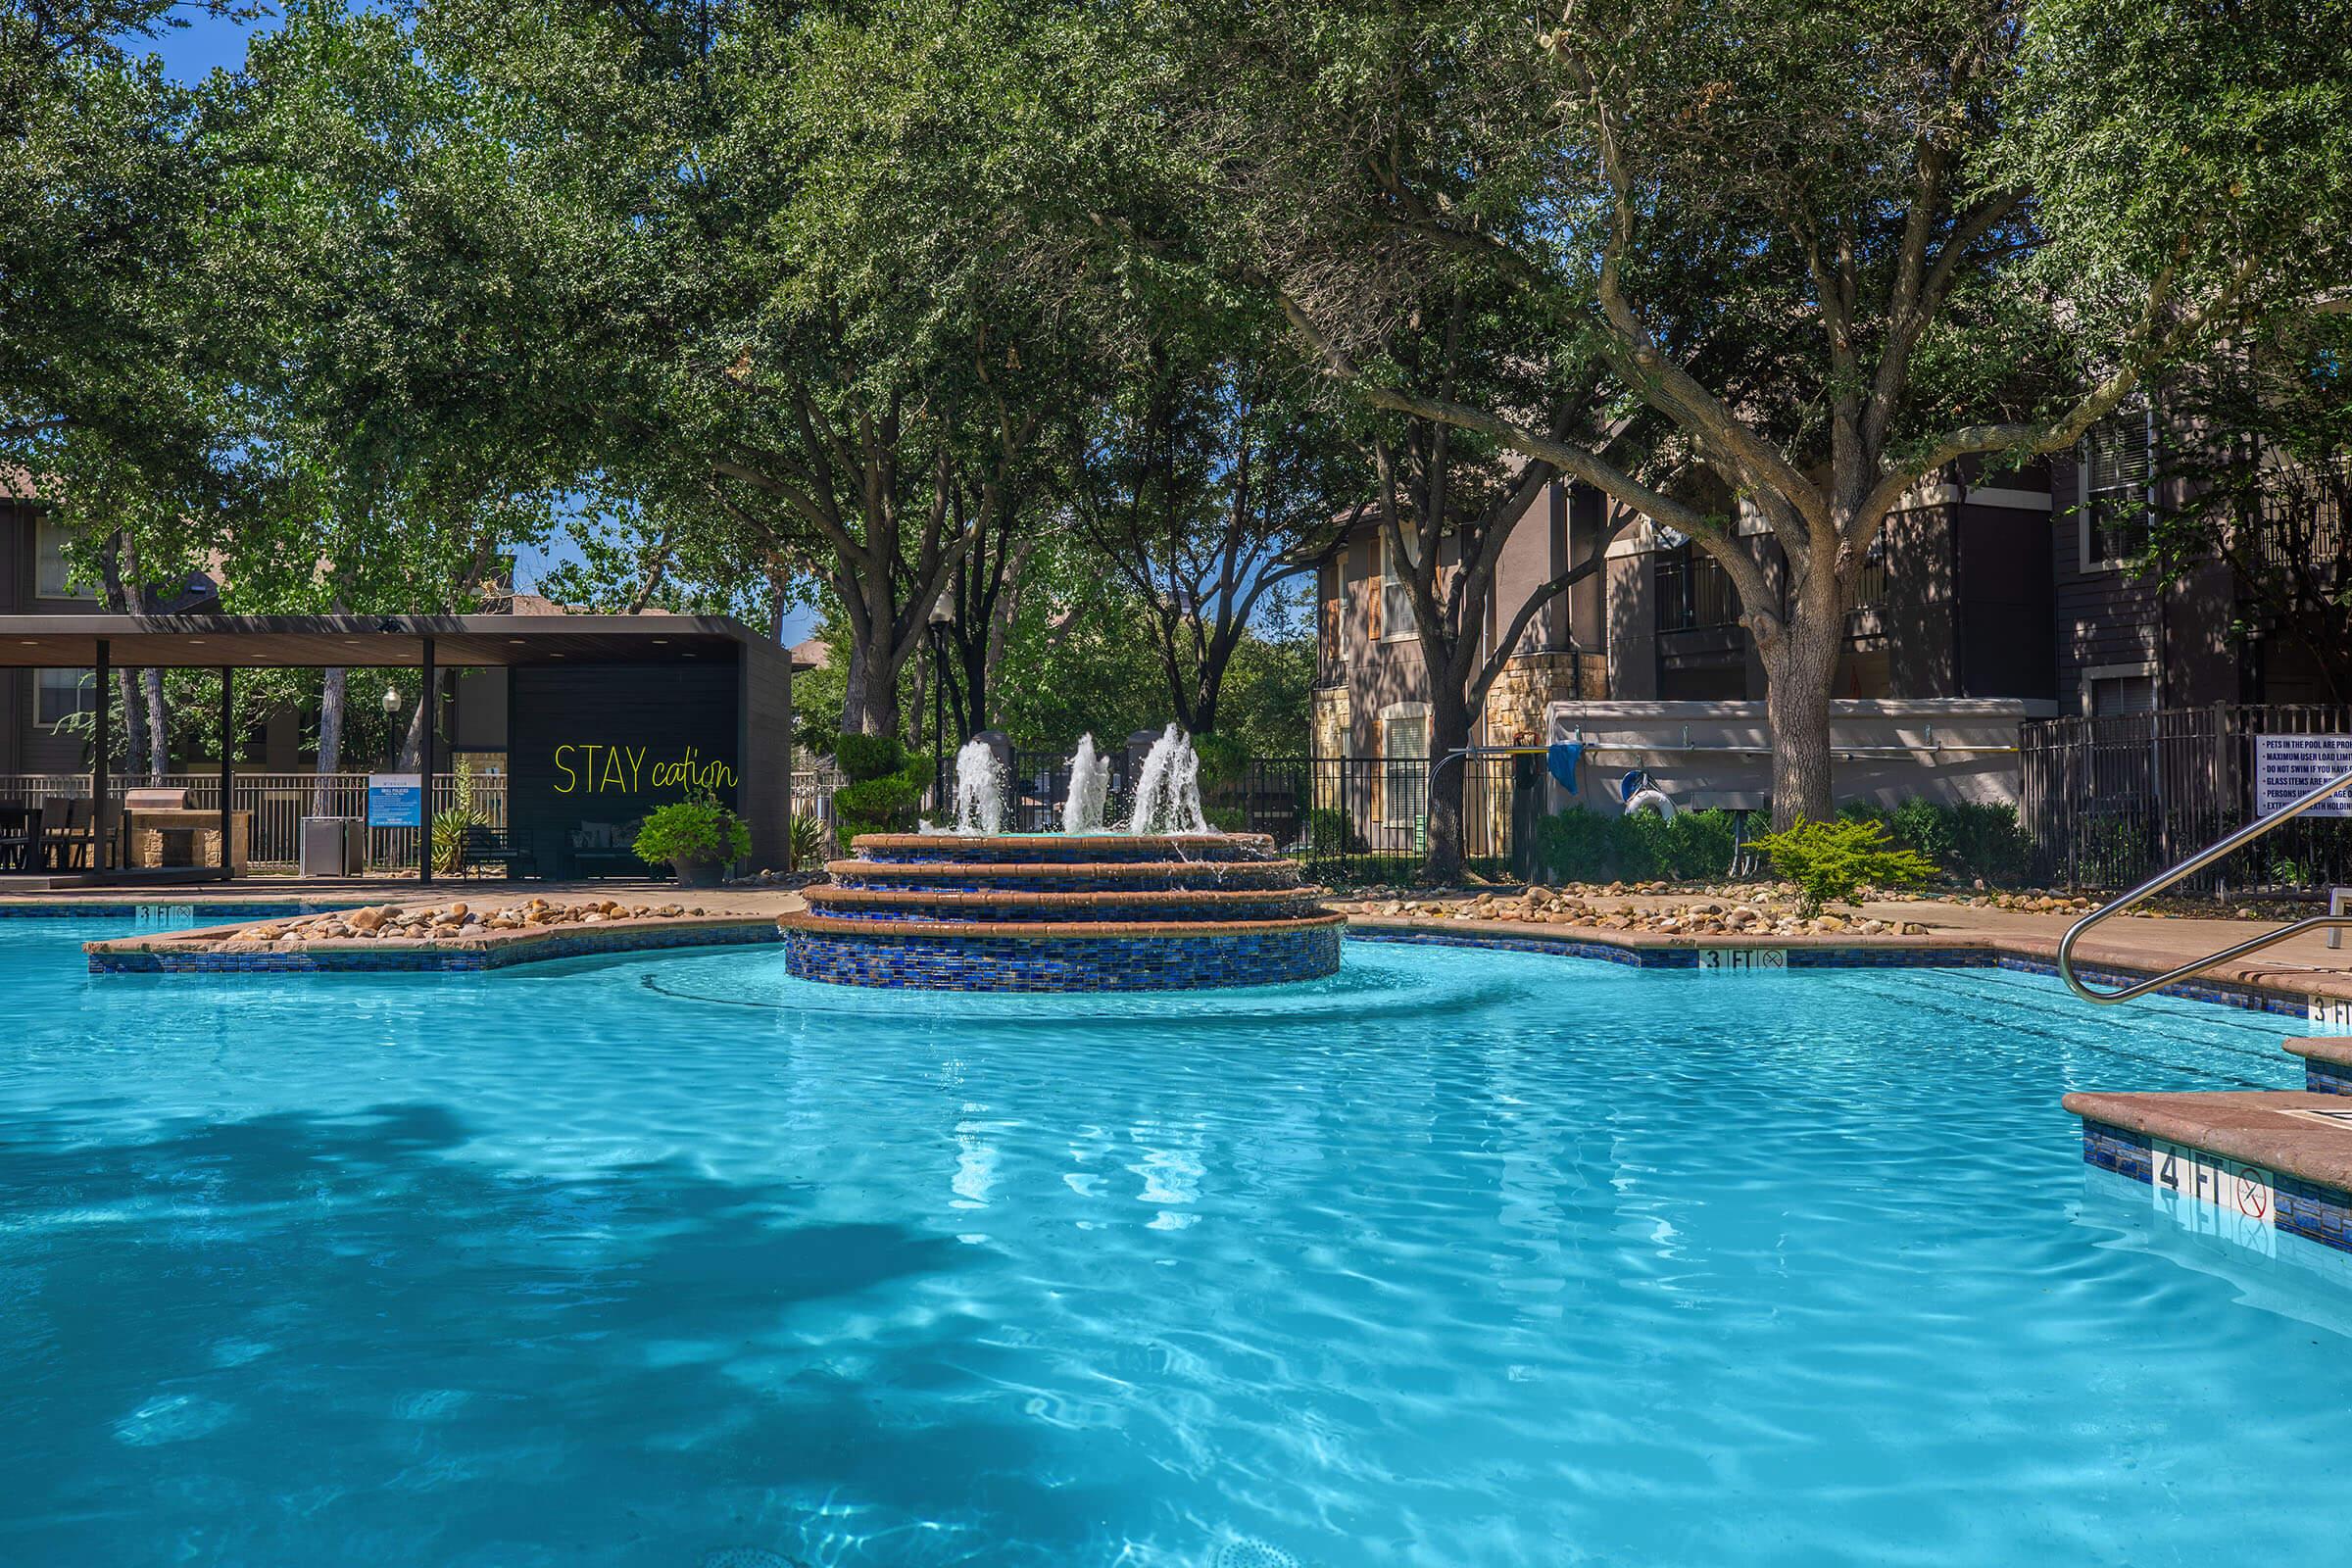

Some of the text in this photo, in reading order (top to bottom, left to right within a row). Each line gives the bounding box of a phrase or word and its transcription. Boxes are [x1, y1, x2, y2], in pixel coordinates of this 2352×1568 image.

[2266, 740, 2282, 749] PETS
[2282, 740, 2290, 749] IN
[2291, 740, 2304, 749] THE
[2304, 740, 2322, 749] POOL
[2323, 740, 2335, 749] ARE
[2266, 753, 2300, 761] MAXIMUM
[2300, 753, 2318, 761] USER
[2318, 753, 2335, 761] LOAD
[554, 745, 739, 793] STAY cation
[2266, 777, 2288, 786] GLASS
[2288, 777, 2309, 786] ITEMS
[2310, 777, 2323, 786] ARE
[2267, 789, 2296, 798] PERSONS
[2333, 789, 2347, 798] AGE
[140, 906, 172, 918] 3 FT
[1707, 950, 1753, 969] 3 FT
[2315, 997, 2352, 1025] 3 FT
[2160, 1146, 2224, 1204] 4 FT
